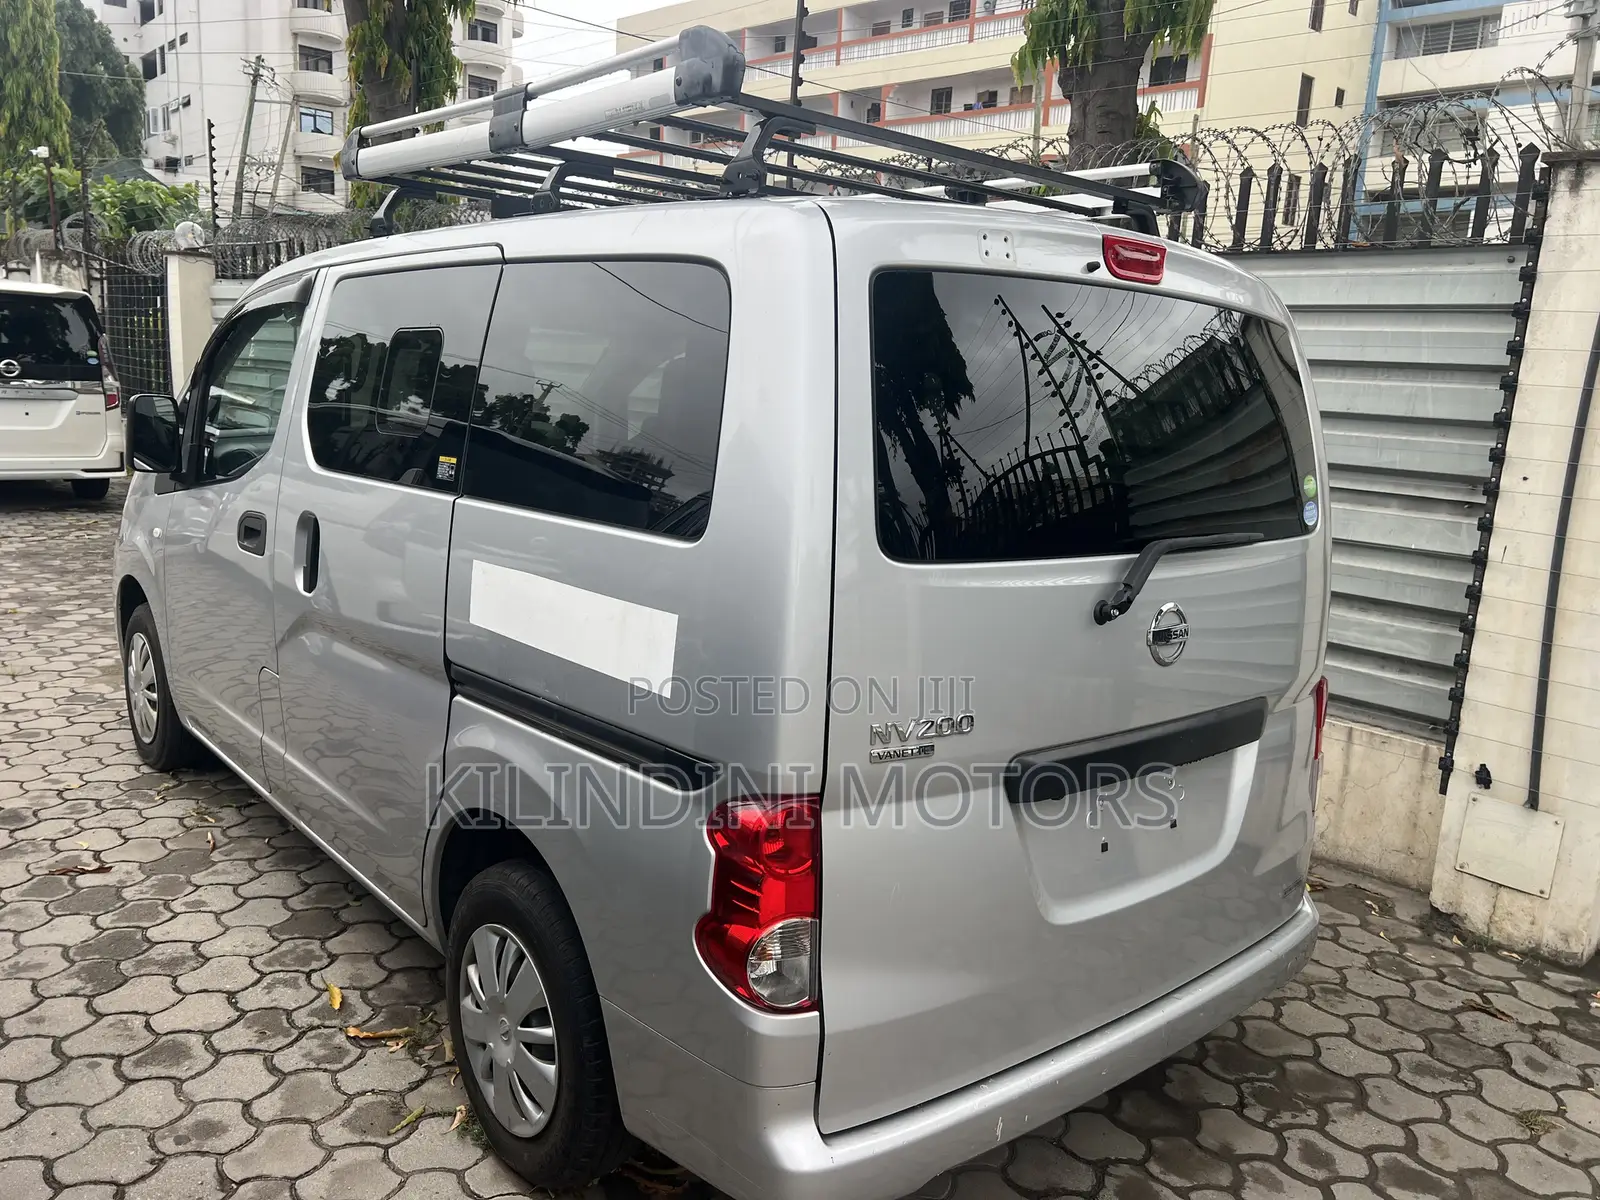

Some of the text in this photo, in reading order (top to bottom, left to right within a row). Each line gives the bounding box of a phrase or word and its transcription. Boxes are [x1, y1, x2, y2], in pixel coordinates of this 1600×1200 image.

[1152, 627, 1189, 643] SSAN
[870, 714, 974, 746] NV200
[877, 745, 932, 760] VANETTE
